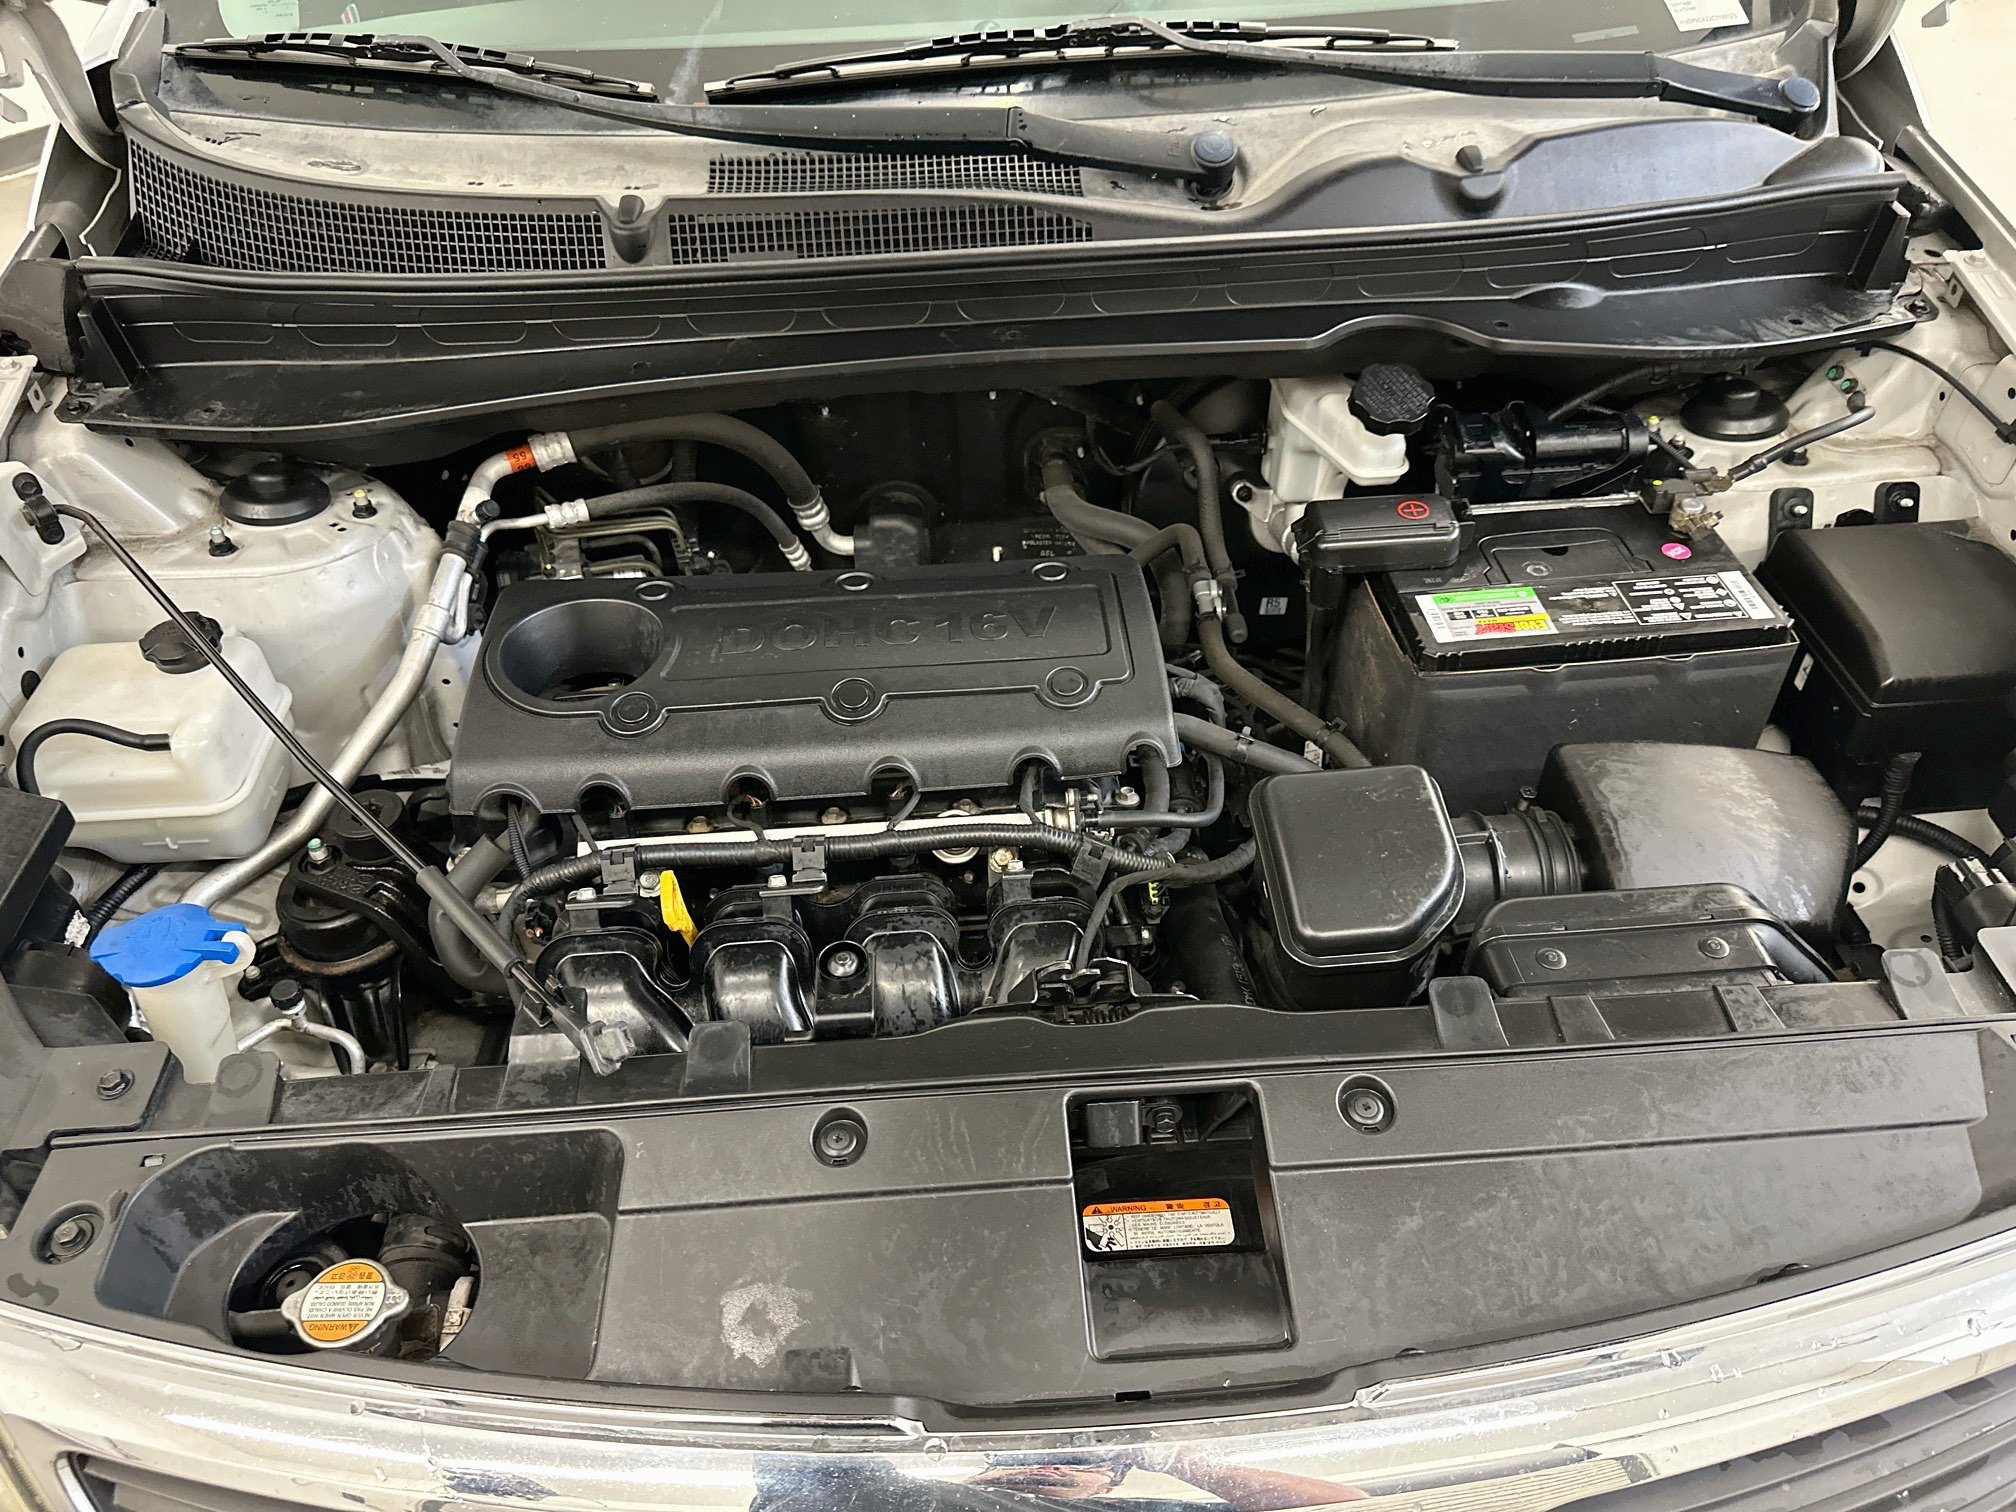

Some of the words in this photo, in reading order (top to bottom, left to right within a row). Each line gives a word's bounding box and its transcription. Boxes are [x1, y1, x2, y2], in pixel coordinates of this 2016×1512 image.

[720, 615, 921, 655] DOHC
[935, 606, 1057, 643] 16V
[1475, 619, 1548, 635] EverStart
[1110, 1204, 1147, 1212] WARNING
